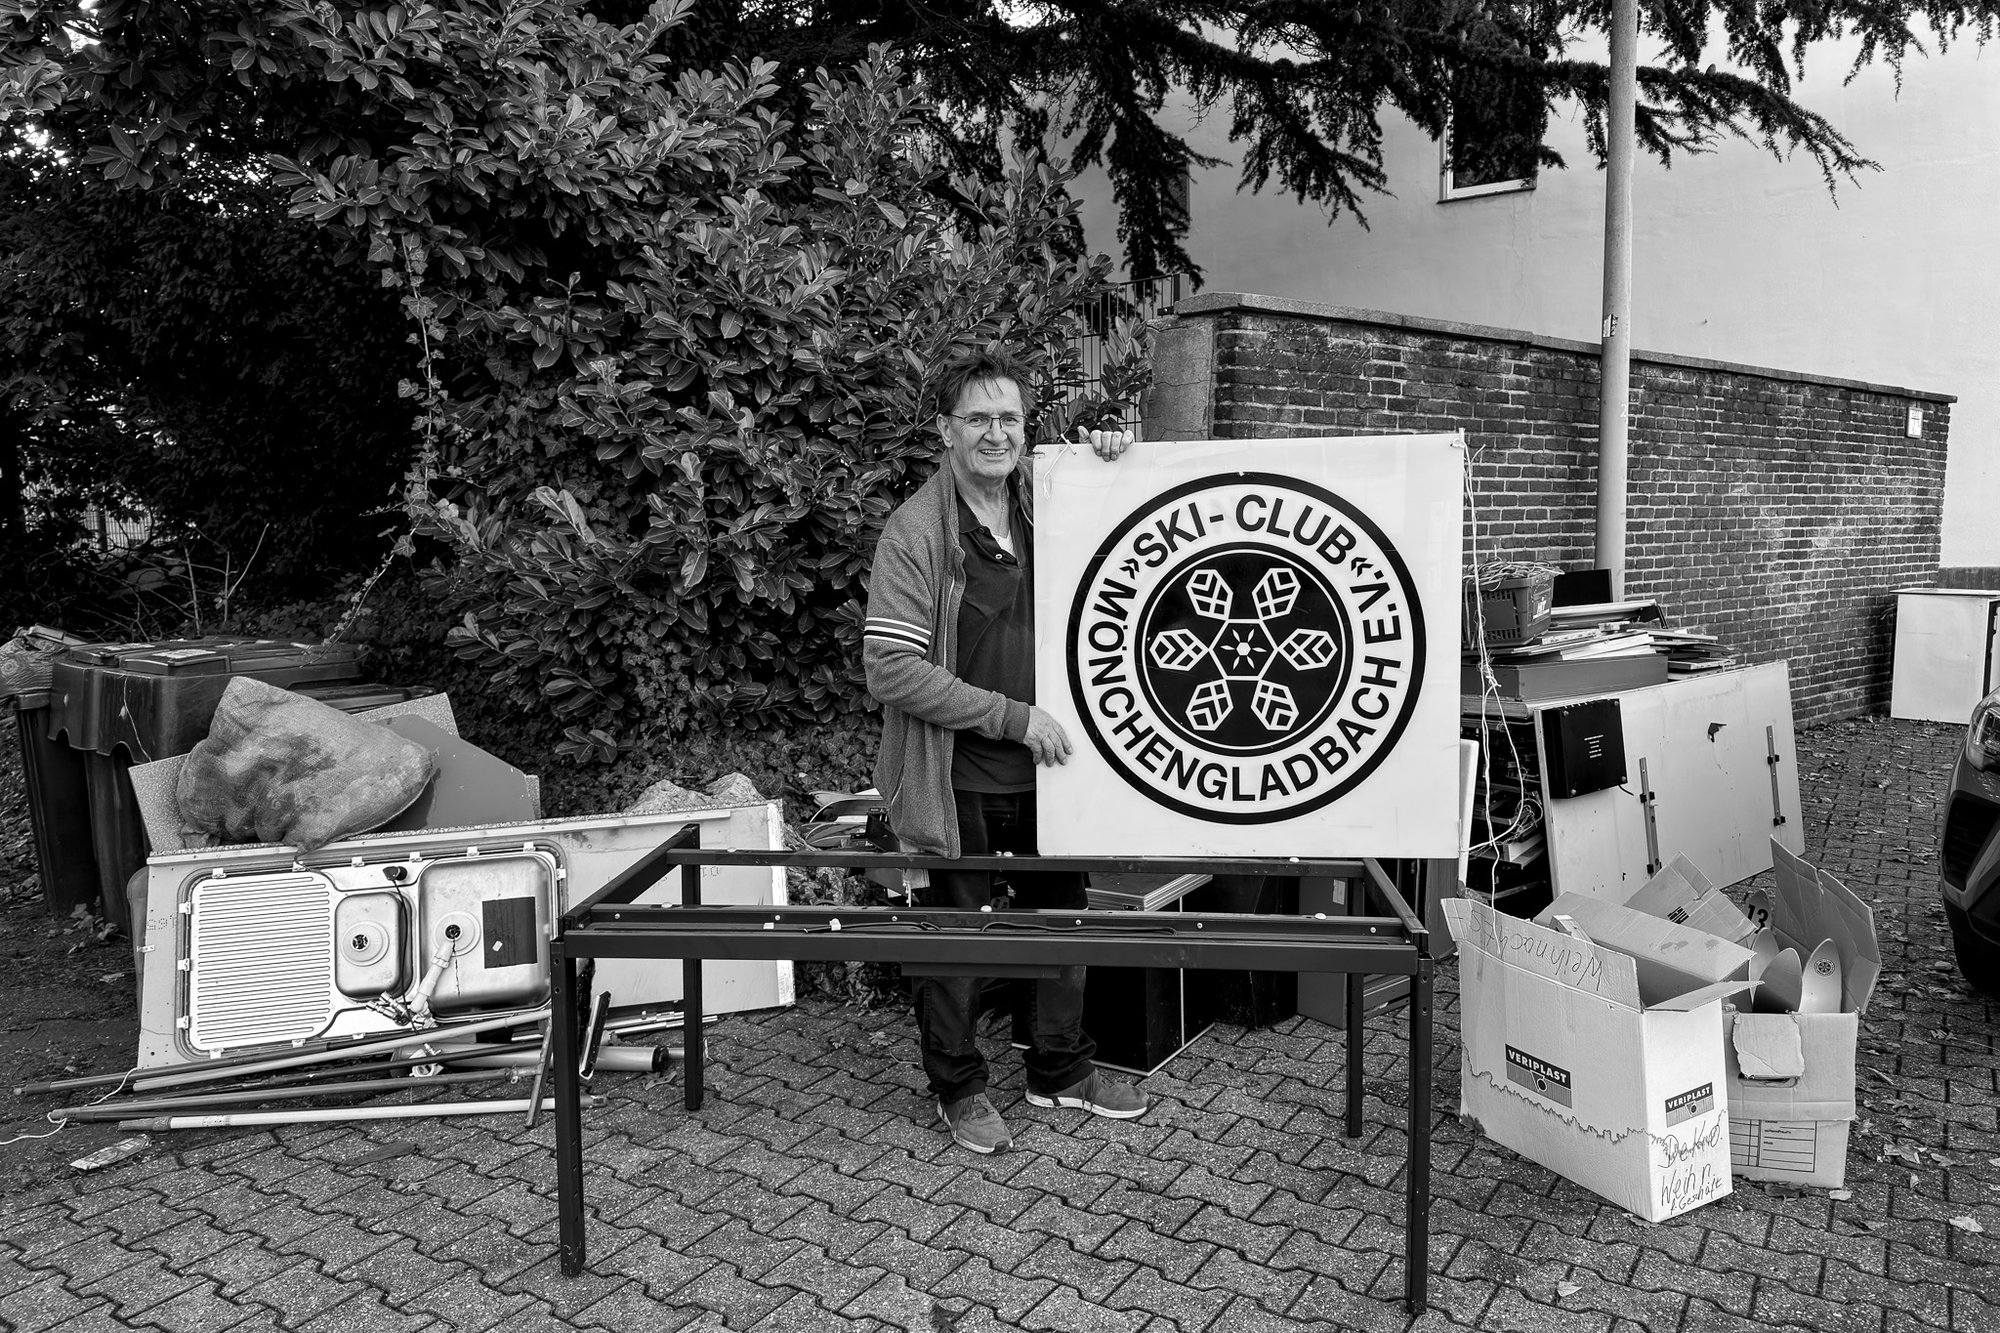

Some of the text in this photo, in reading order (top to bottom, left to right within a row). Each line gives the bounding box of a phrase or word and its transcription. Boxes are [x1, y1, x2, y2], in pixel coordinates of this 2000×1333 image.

[1088, 577, 1401, 801] MÖNCHENGLADBACH
[1507, 1048, 1568, 1084] VERIPLAST
[1667, 1086, 1711, 1110] VERIPLAST
